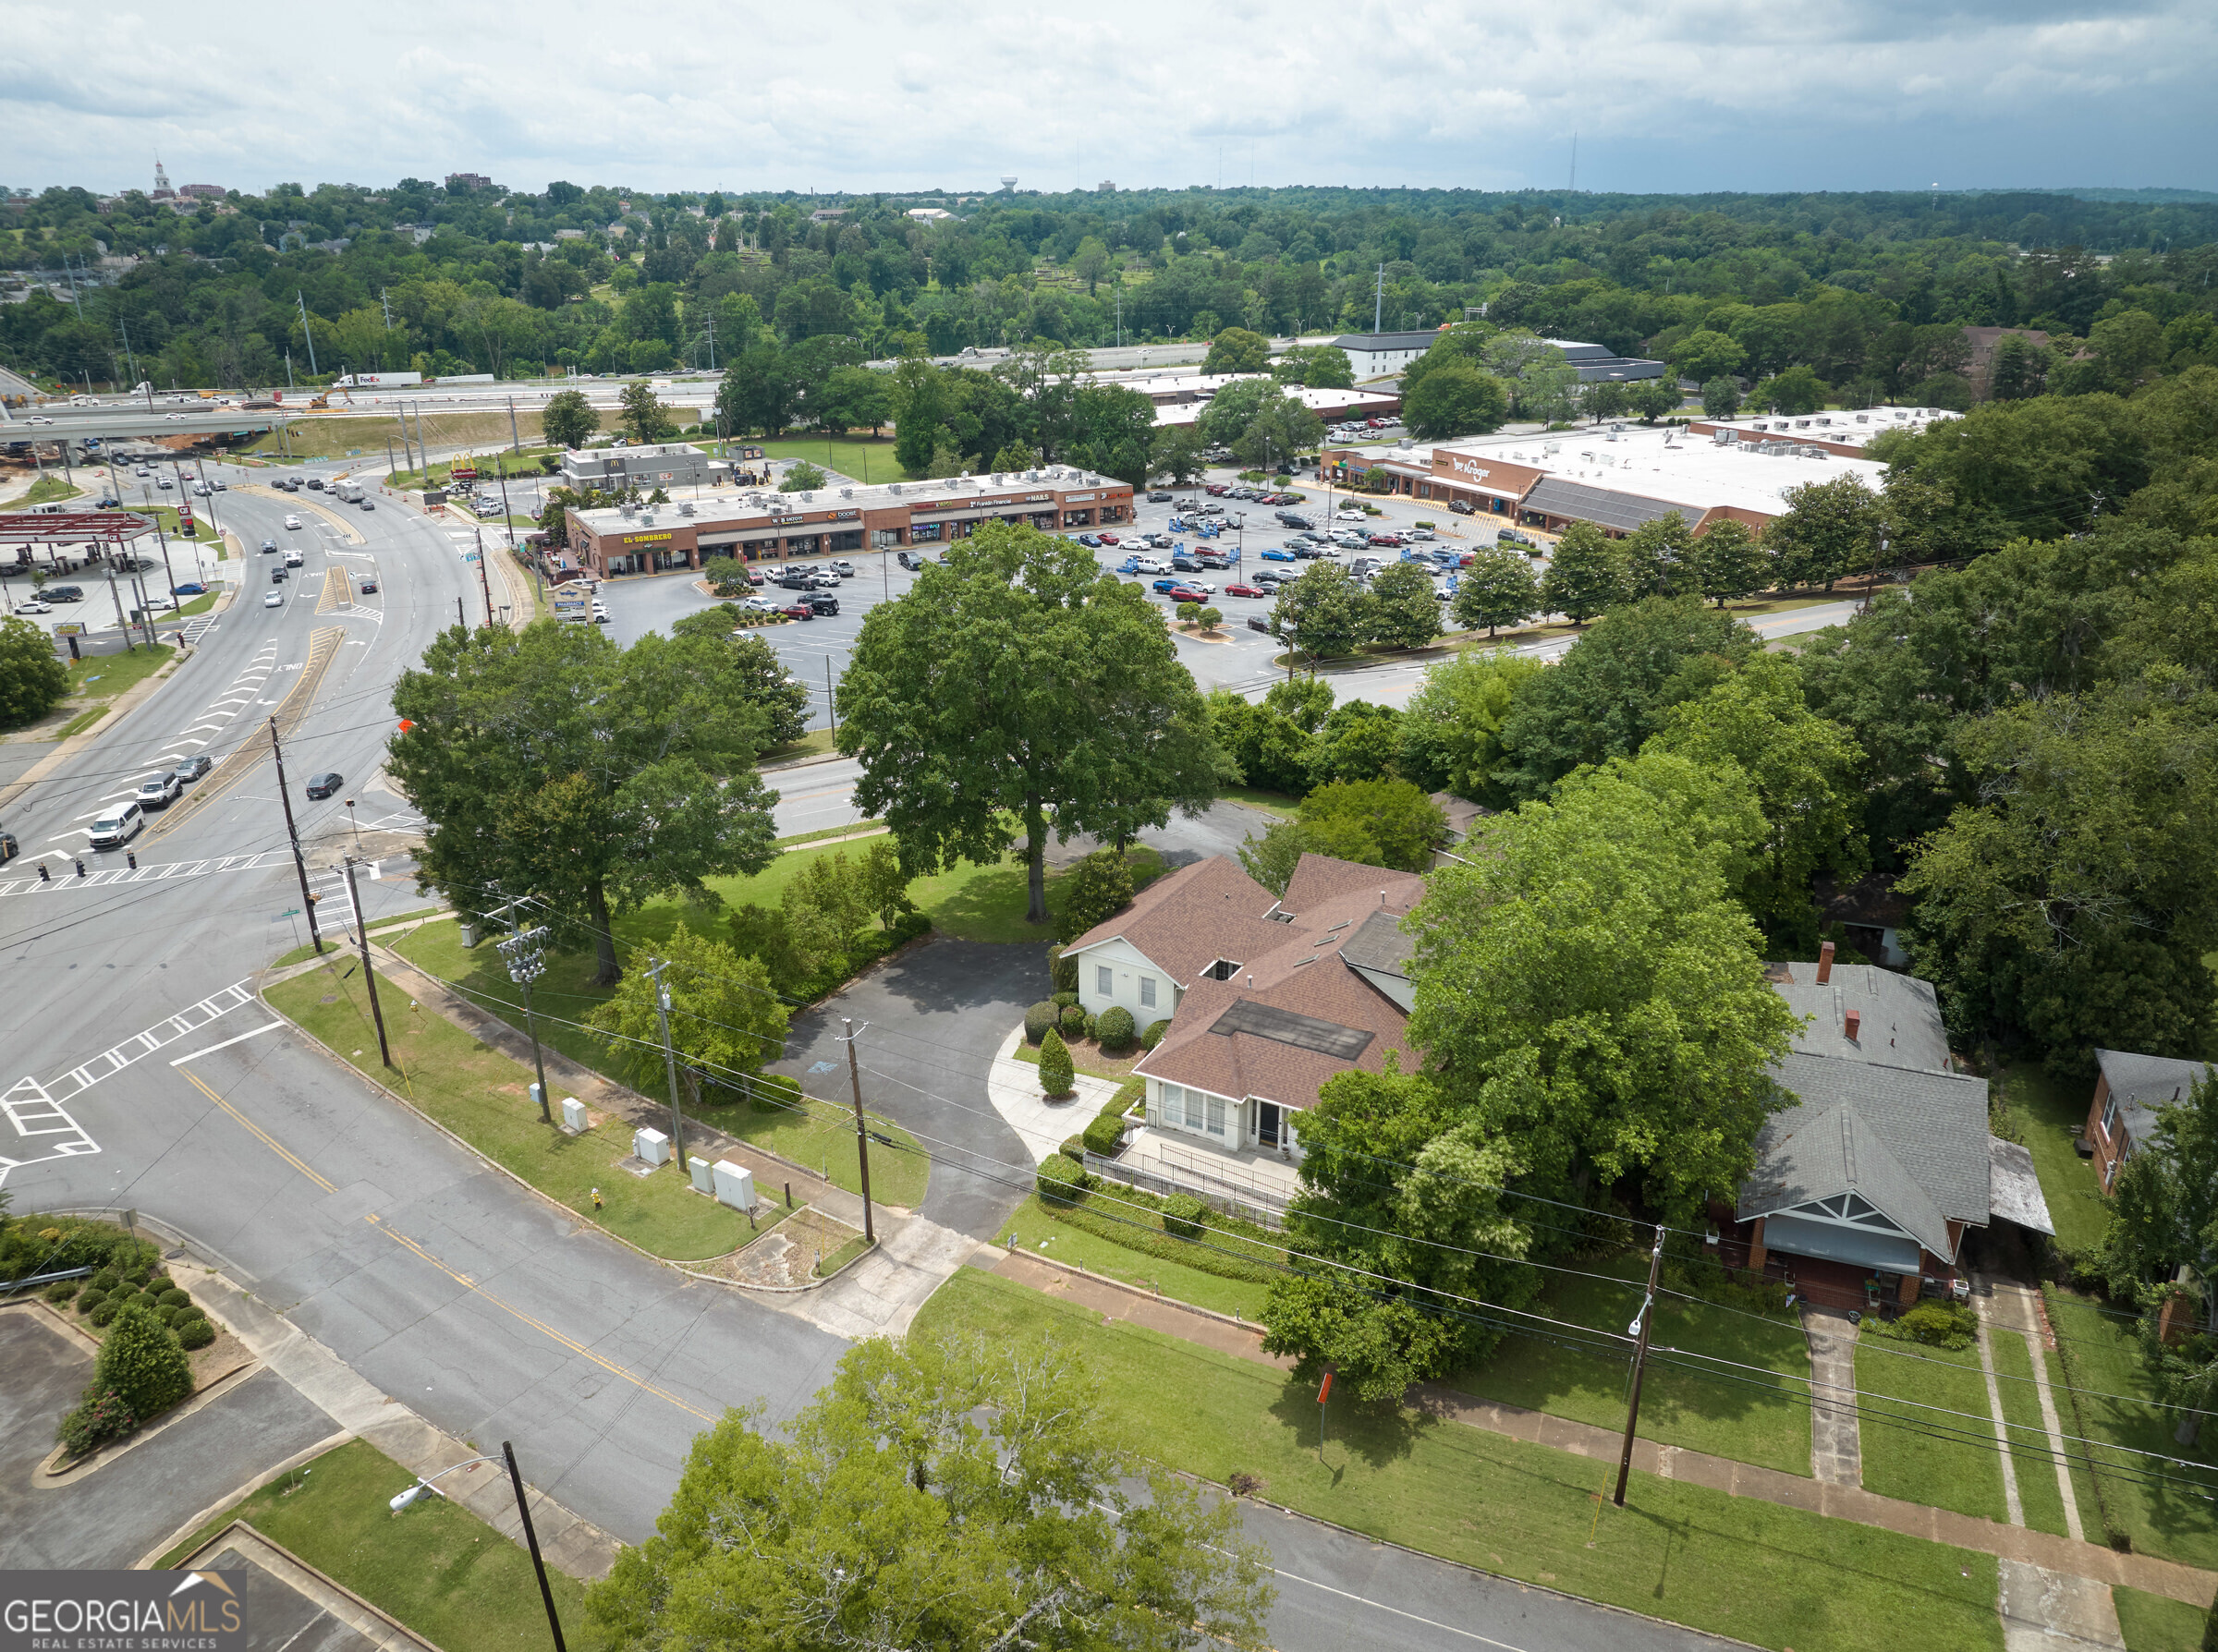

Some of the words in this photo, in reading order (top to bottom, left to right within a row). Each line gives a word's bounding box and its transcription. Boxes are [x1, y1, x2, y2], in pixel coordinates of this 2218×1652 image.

[1463, 459, 1491, 482] Kroger
[1030, 493, 1049, 502] NAILS
[976, 499, 993, 507] Franklin
[635, 533, 672, 543] SOMBRERO
[274, 662, 303, 673] ONLY
